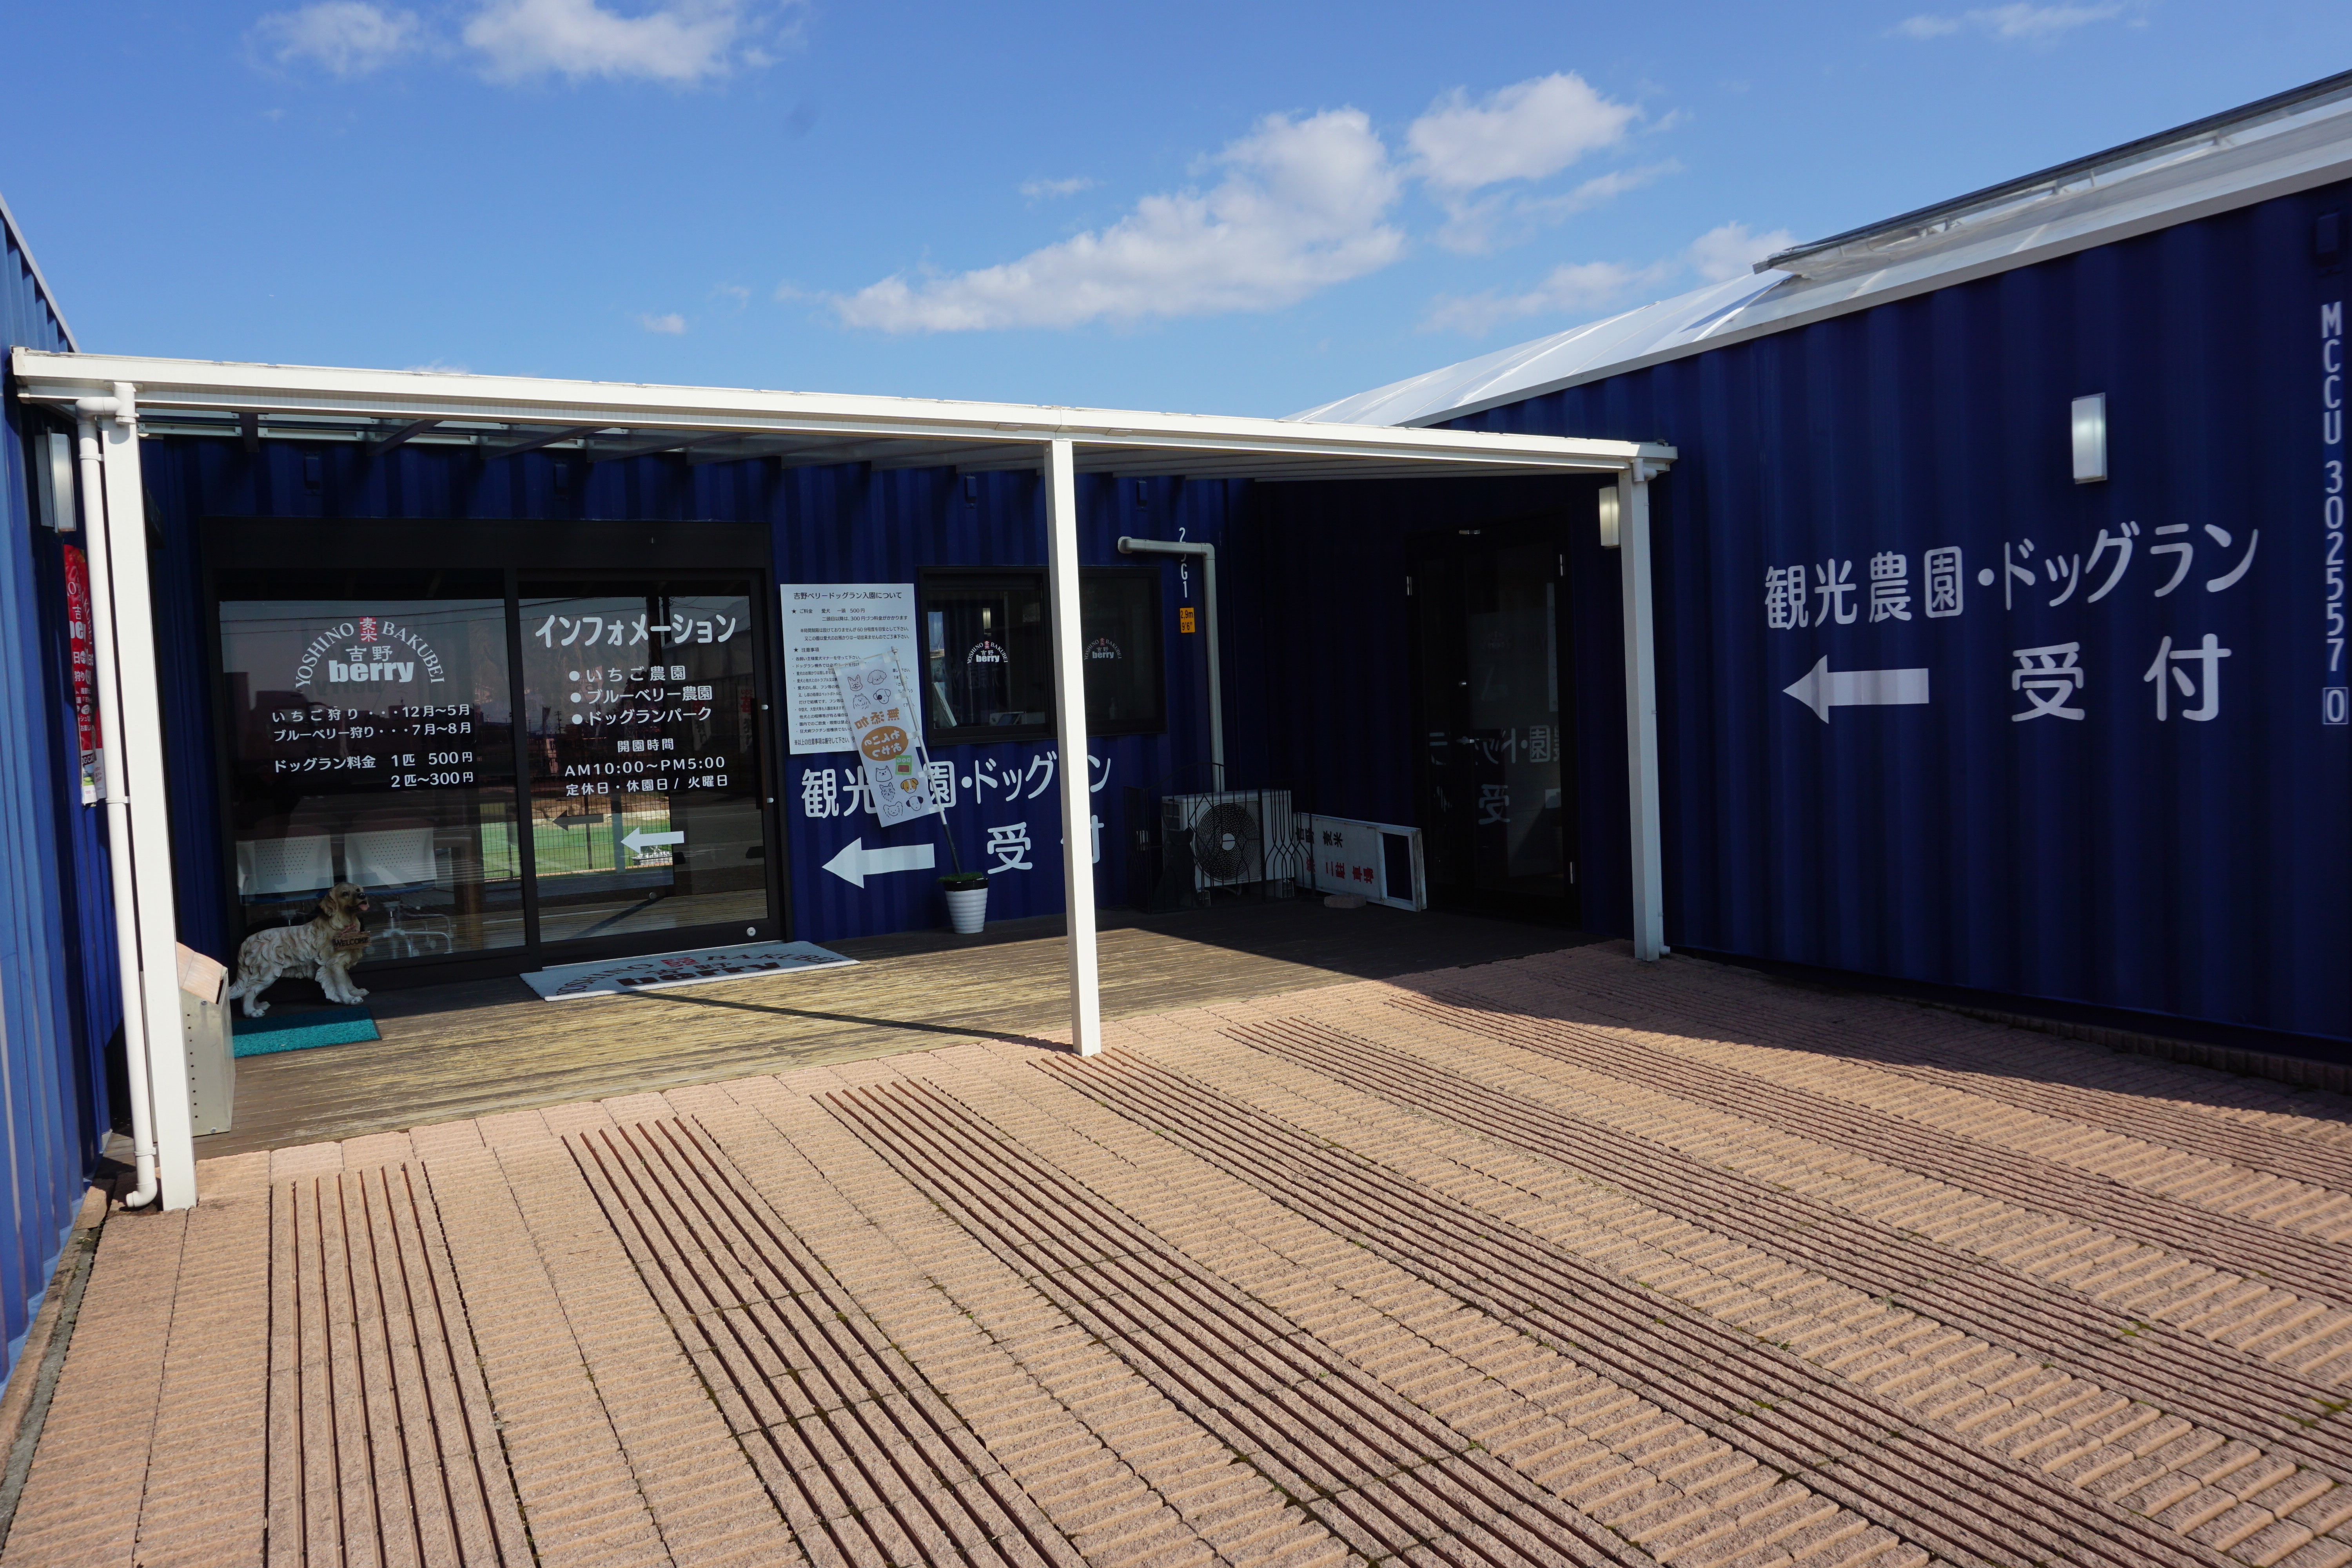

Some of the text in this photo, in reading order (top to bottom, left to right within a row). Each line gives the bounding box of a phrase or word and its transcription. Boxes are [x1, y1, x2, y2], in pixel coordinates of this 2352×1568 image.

[2321, 301, 2342, 445] MCCU
[1764, 520, 2259, 630] 観光農園・ドッグラン
[2325, 460, 2345, 671] 302557
[793, 591, 902, 600] 吉野ベリードッグラン入園について
[535, 613, 736, 648] インフォメーション
[295, 621, 445, 690] YOSHINO BAKUBEI
[345, 645, 393, 662] 吉野
[967, 642, 1008, 664] YOSHINO BAKUBEI
[328, 660, 414, 683] berry
[586, 665, 686, 682] いちご農園
[2011, 633, 2232, 722] 受付
[588, 685, 713, 705] ブルーベリー農園
[589, 706, 712, 726] ドッグランパーク
[617, 738, 674, 753] 開園時間
[275, 755, 376, 773] ドッグラン料金
